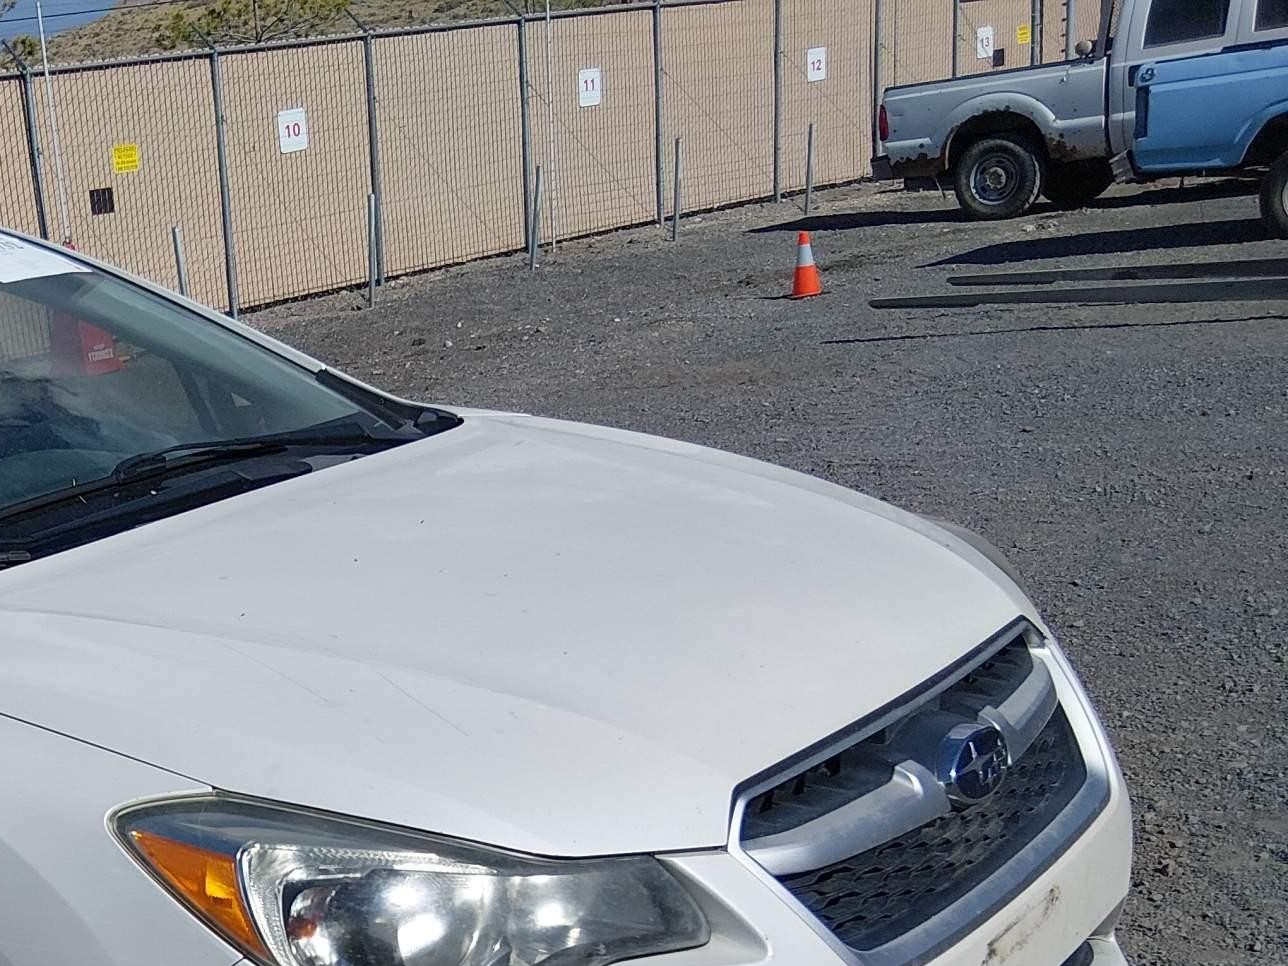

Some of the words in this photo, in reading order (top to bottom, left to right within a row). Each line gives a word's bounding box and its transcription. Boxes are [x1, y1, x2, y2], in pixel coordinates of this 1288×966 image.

[980, 37, 990, 48] 13
[811, 59, 822, 72] 12
[583, 78, 595, 92] 11
[285, 122, 301, 139] 10
